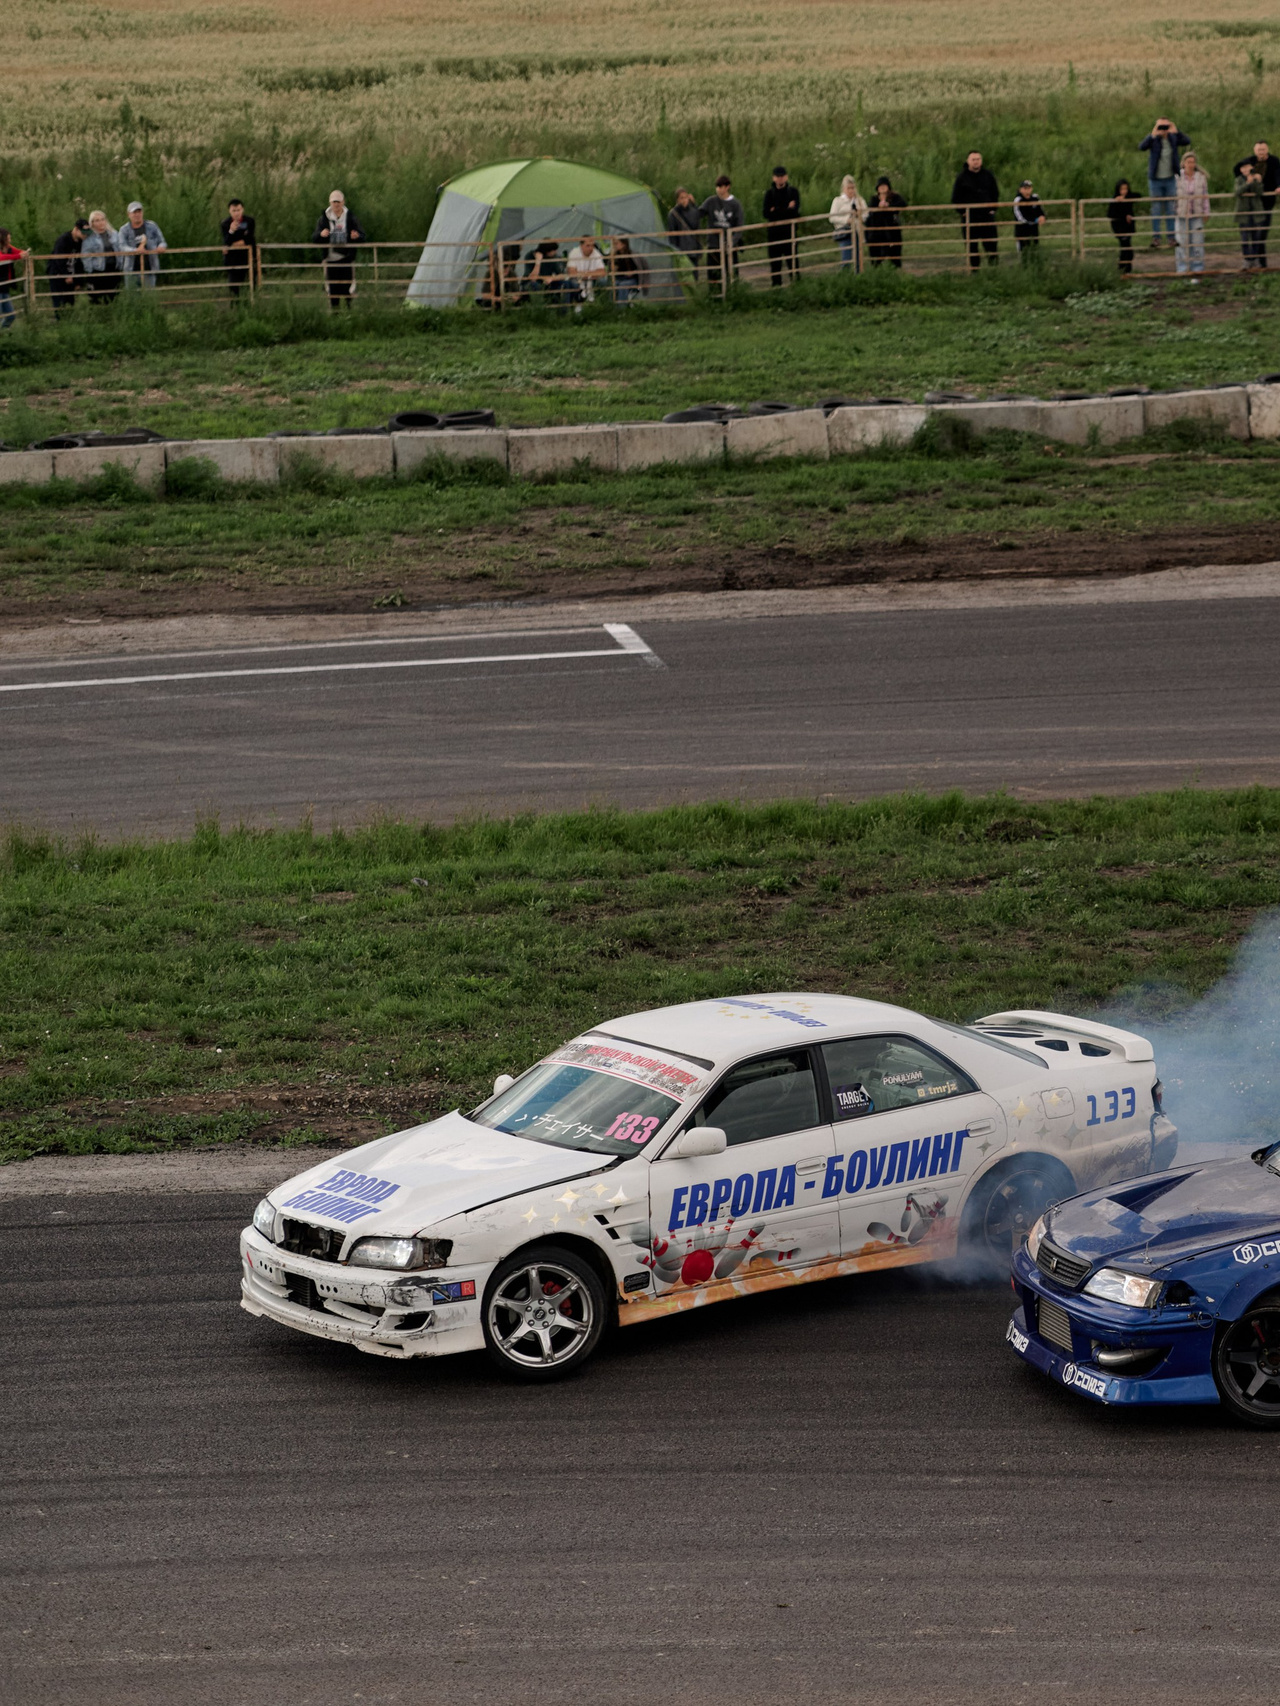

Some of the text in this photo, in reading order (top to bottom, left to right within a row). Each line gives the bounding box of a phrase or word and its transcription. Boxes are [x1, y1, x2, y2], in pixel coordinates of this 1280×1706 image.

[655, 1063, 698, 1085] РАКЕТЫ
[883, 1071, 923, 1085] PONULYAM
[837, 1091, 870, 1105] TARGE
[1087, 1087, 1136, 1126] 133
[604, 1112, 659, 1144] 133
[314, 1169, 401, 1204] ЕВРОПА
[668, 1164, 797, 1231] ЕВРОПА
[822, 1129, 970, 1199] БОУЛИНГ
[282, 1190, 382, 1224] БОУЛИНГ
[1074, 1370, 1106, 1397] СОЮЗ
